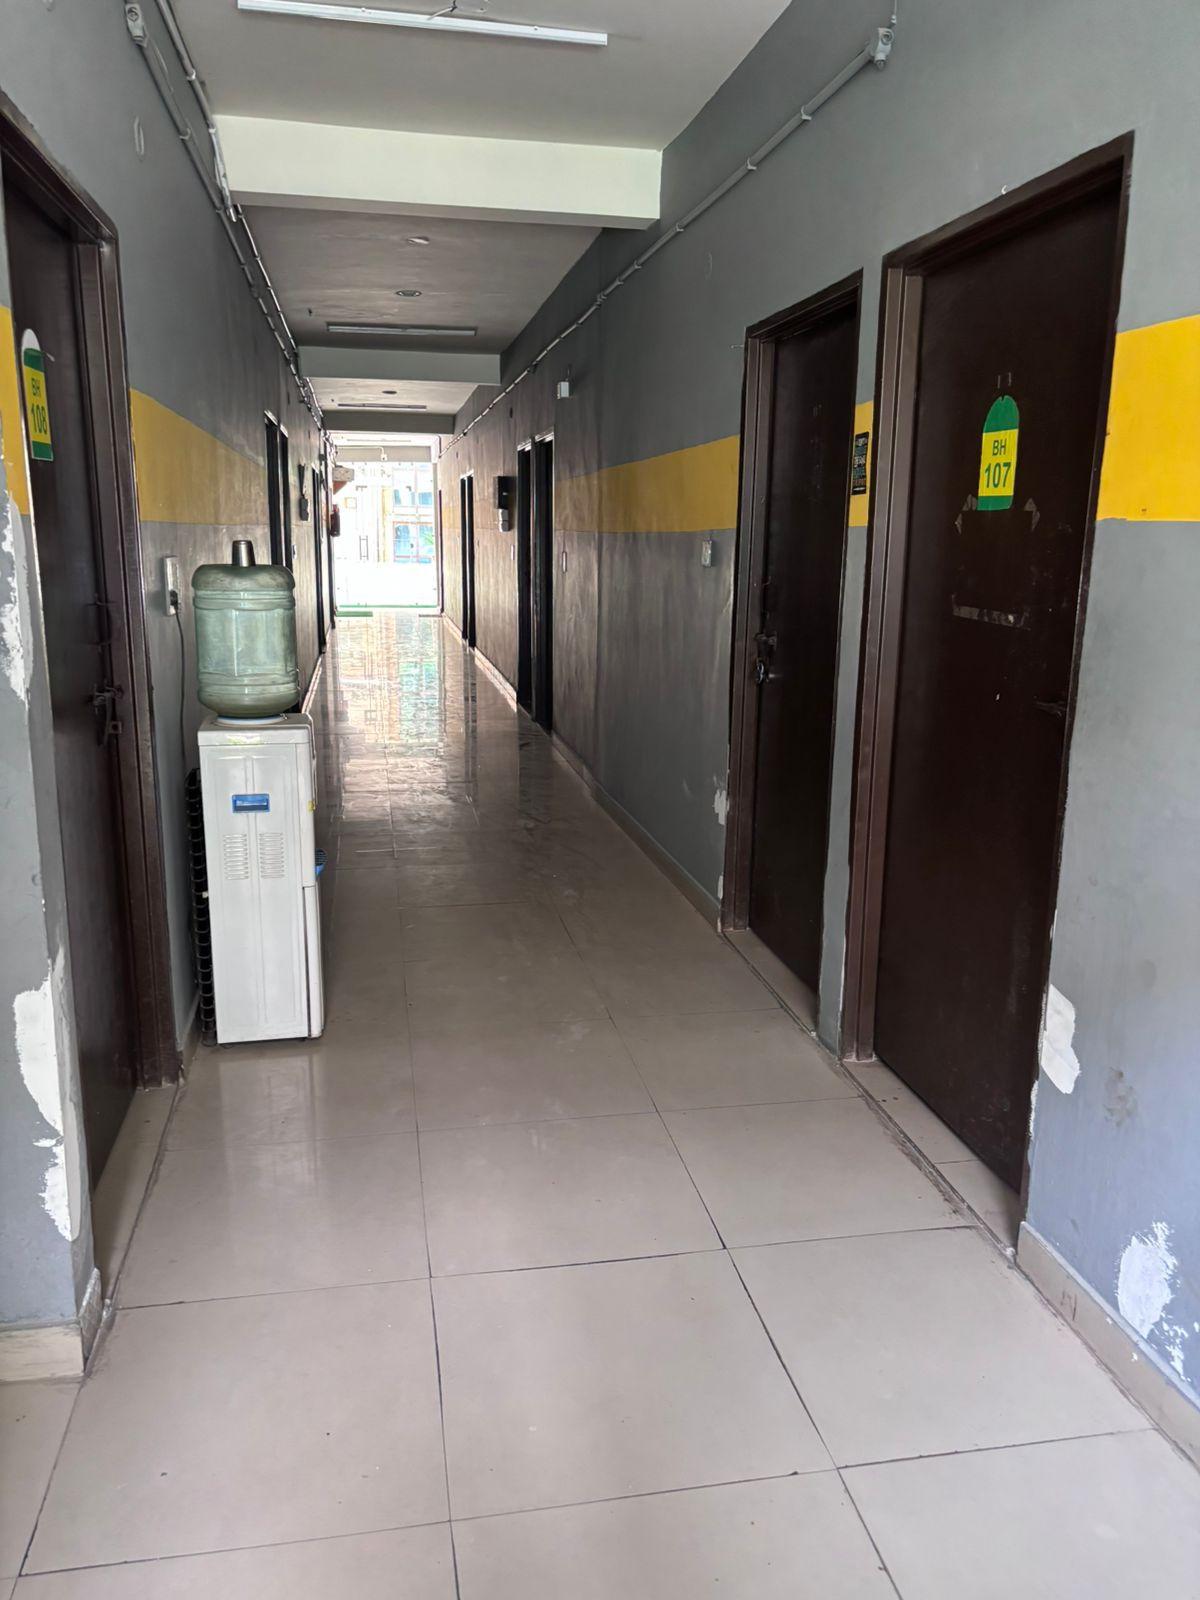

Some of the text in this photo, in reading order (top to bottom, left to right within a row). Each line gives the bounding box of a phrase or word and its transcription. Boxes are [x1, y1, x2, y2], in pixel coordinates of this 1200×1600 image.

[31, 378, 42, 396] BH
[31, 403, 47, 435] 108
[992, 438, 1007, 456] BH
[984, 461, 1011, 488] 107
